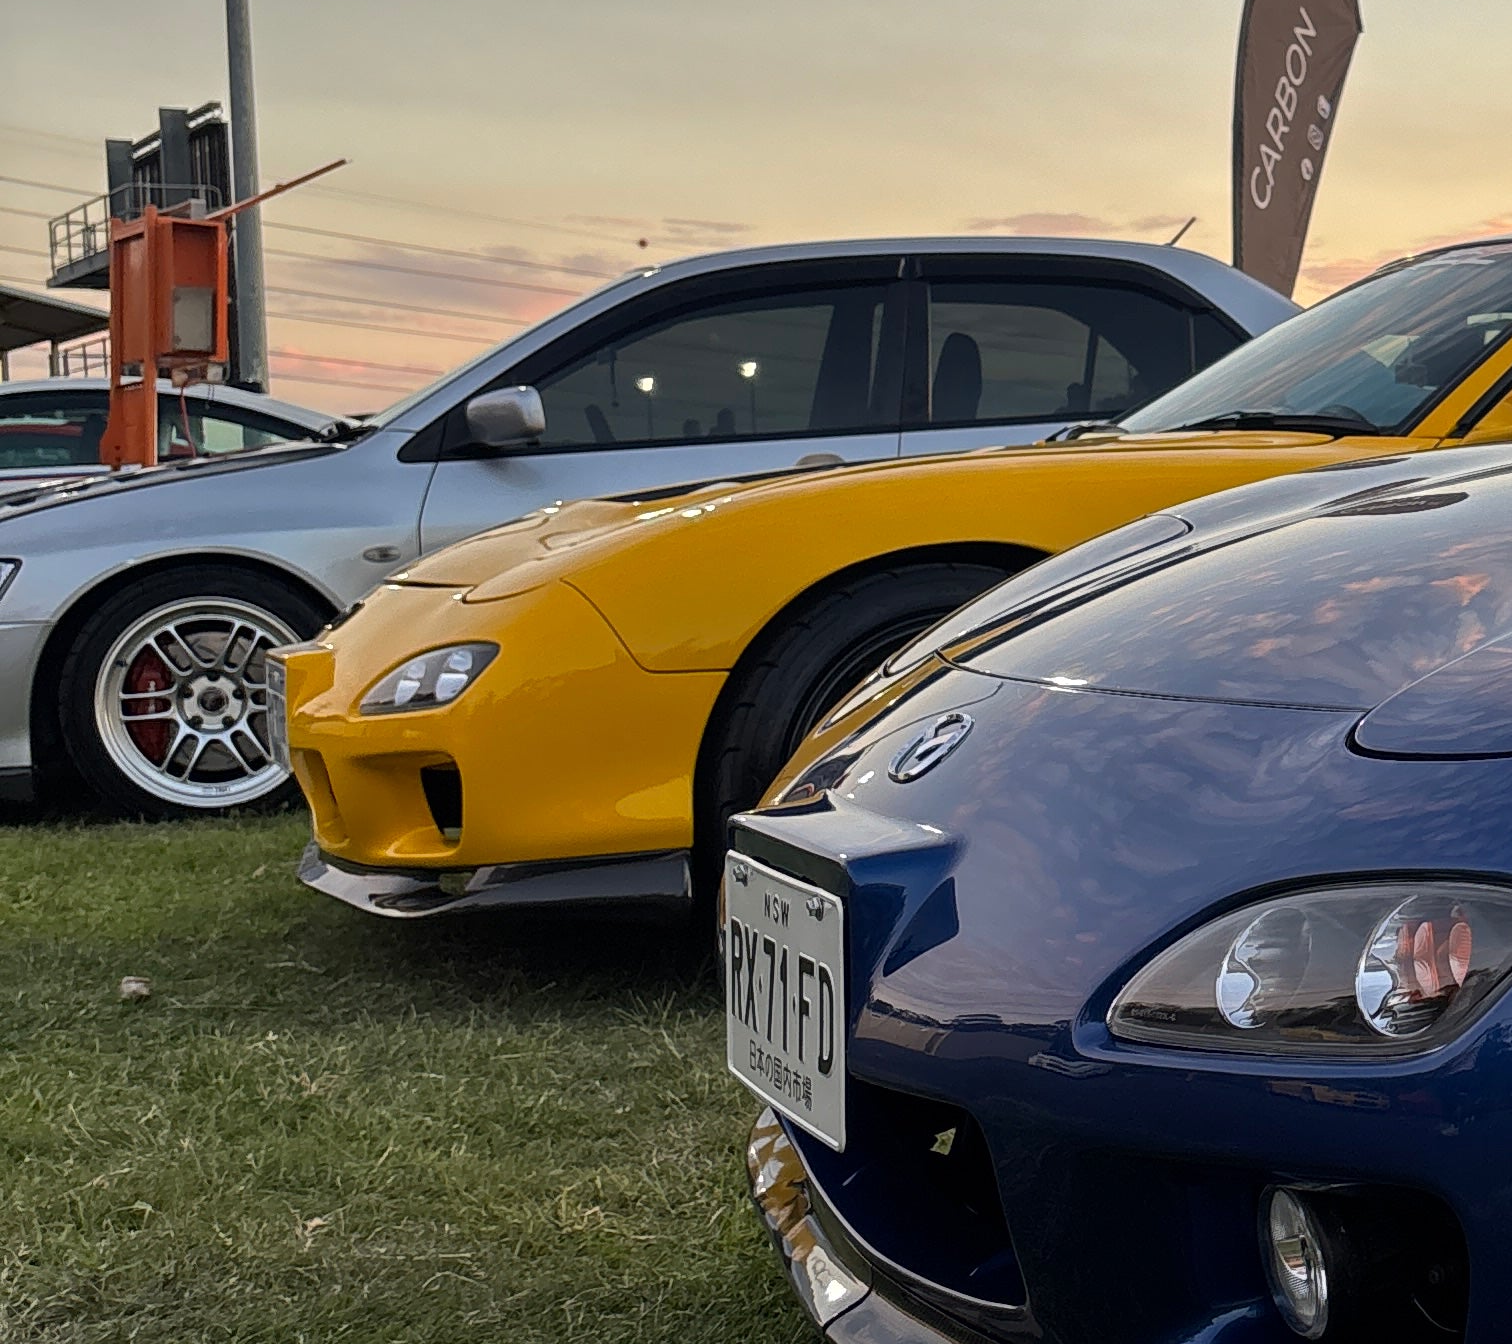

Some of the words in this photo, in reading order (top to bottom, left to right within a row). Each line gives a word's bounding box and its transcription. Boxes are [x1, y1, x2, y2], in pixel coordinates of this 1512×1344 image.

[1250, 7, 1318, 210] CARBON
[763, 891, 790, 929] NSW
[749, 1039, 813, 1112] 日本の国内市場
